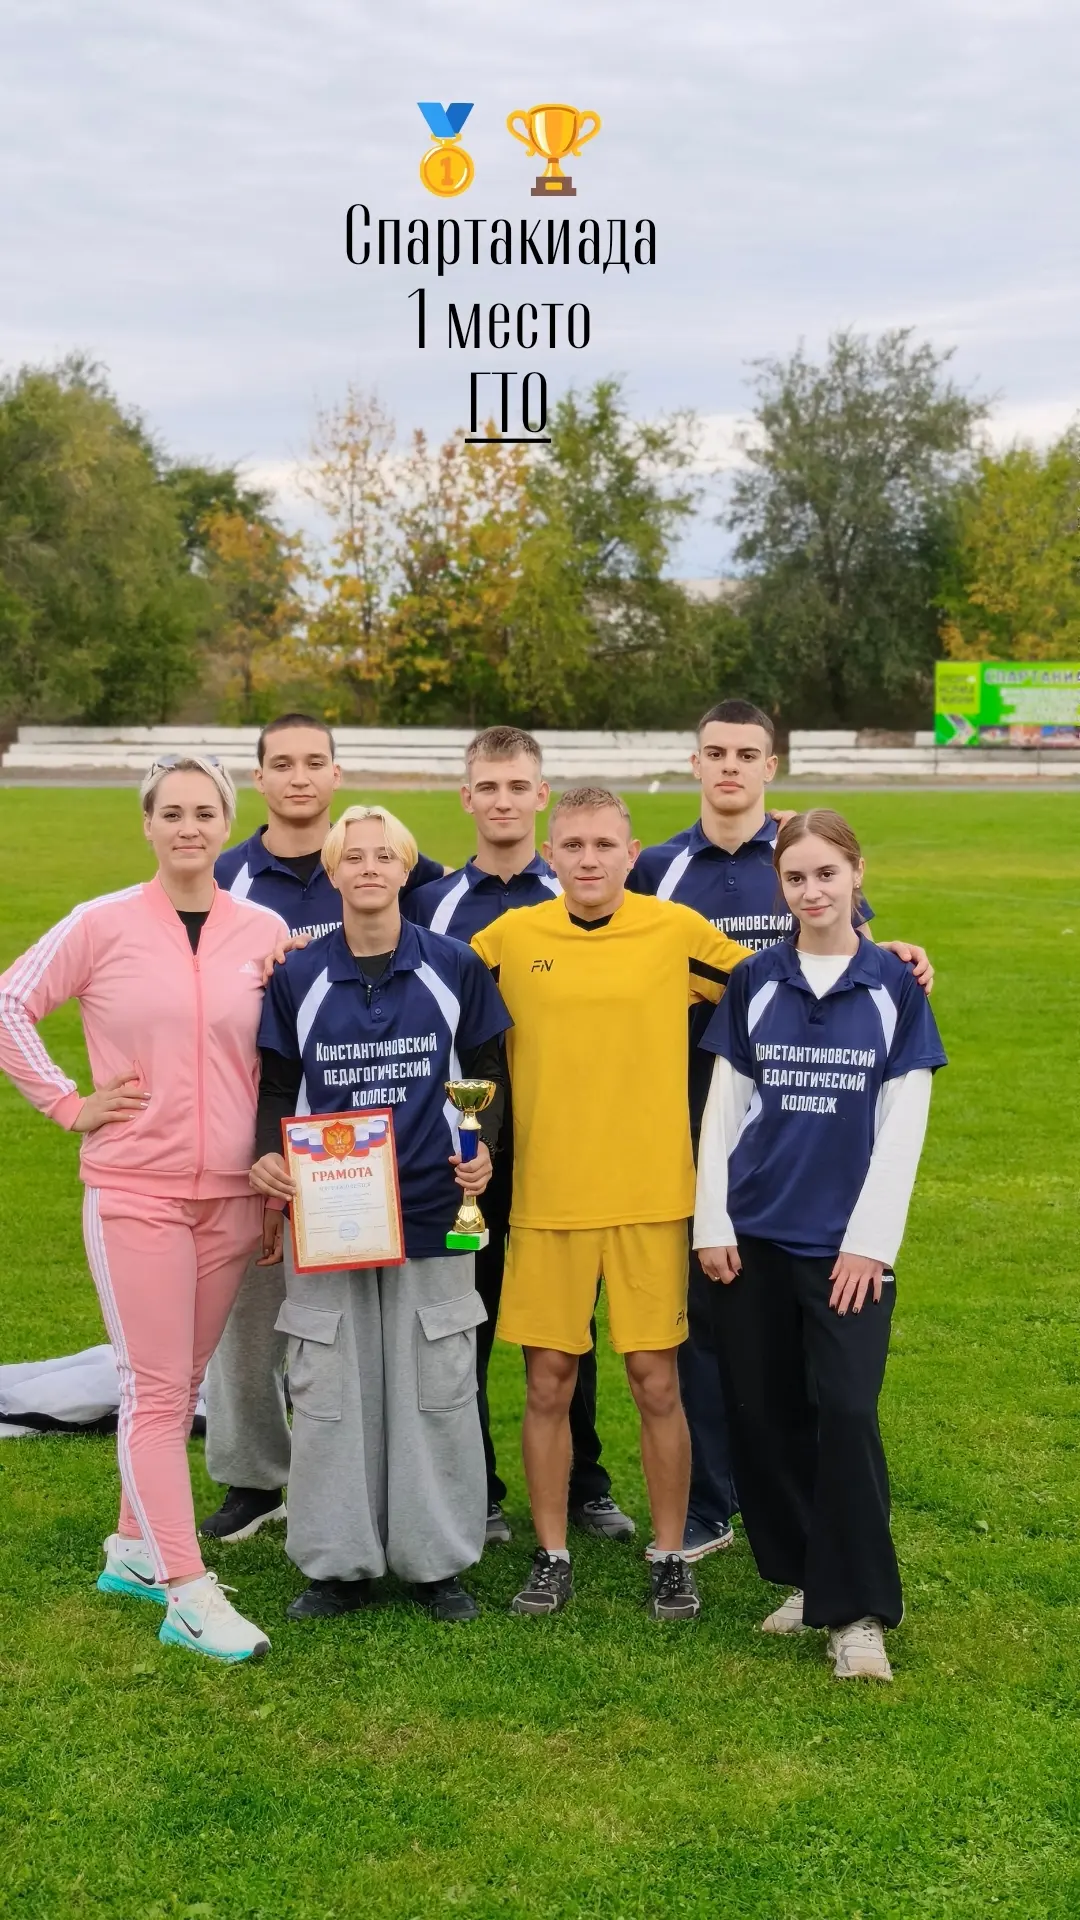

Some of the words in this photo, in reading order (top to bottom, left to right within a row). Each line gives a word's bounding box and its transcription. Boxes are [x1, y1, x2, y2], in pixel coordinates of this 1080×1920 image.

[323, 1057, 431, 1086] ПЕДАГОГИЧЕСКИЙ
[352, 1086, 407, 1107] КОЛЛЕДЖ
[781, 1094, 838, 1114] КОЛЛЕДЖ
[312, 1166, 373, 1183] ГРАМОТА
